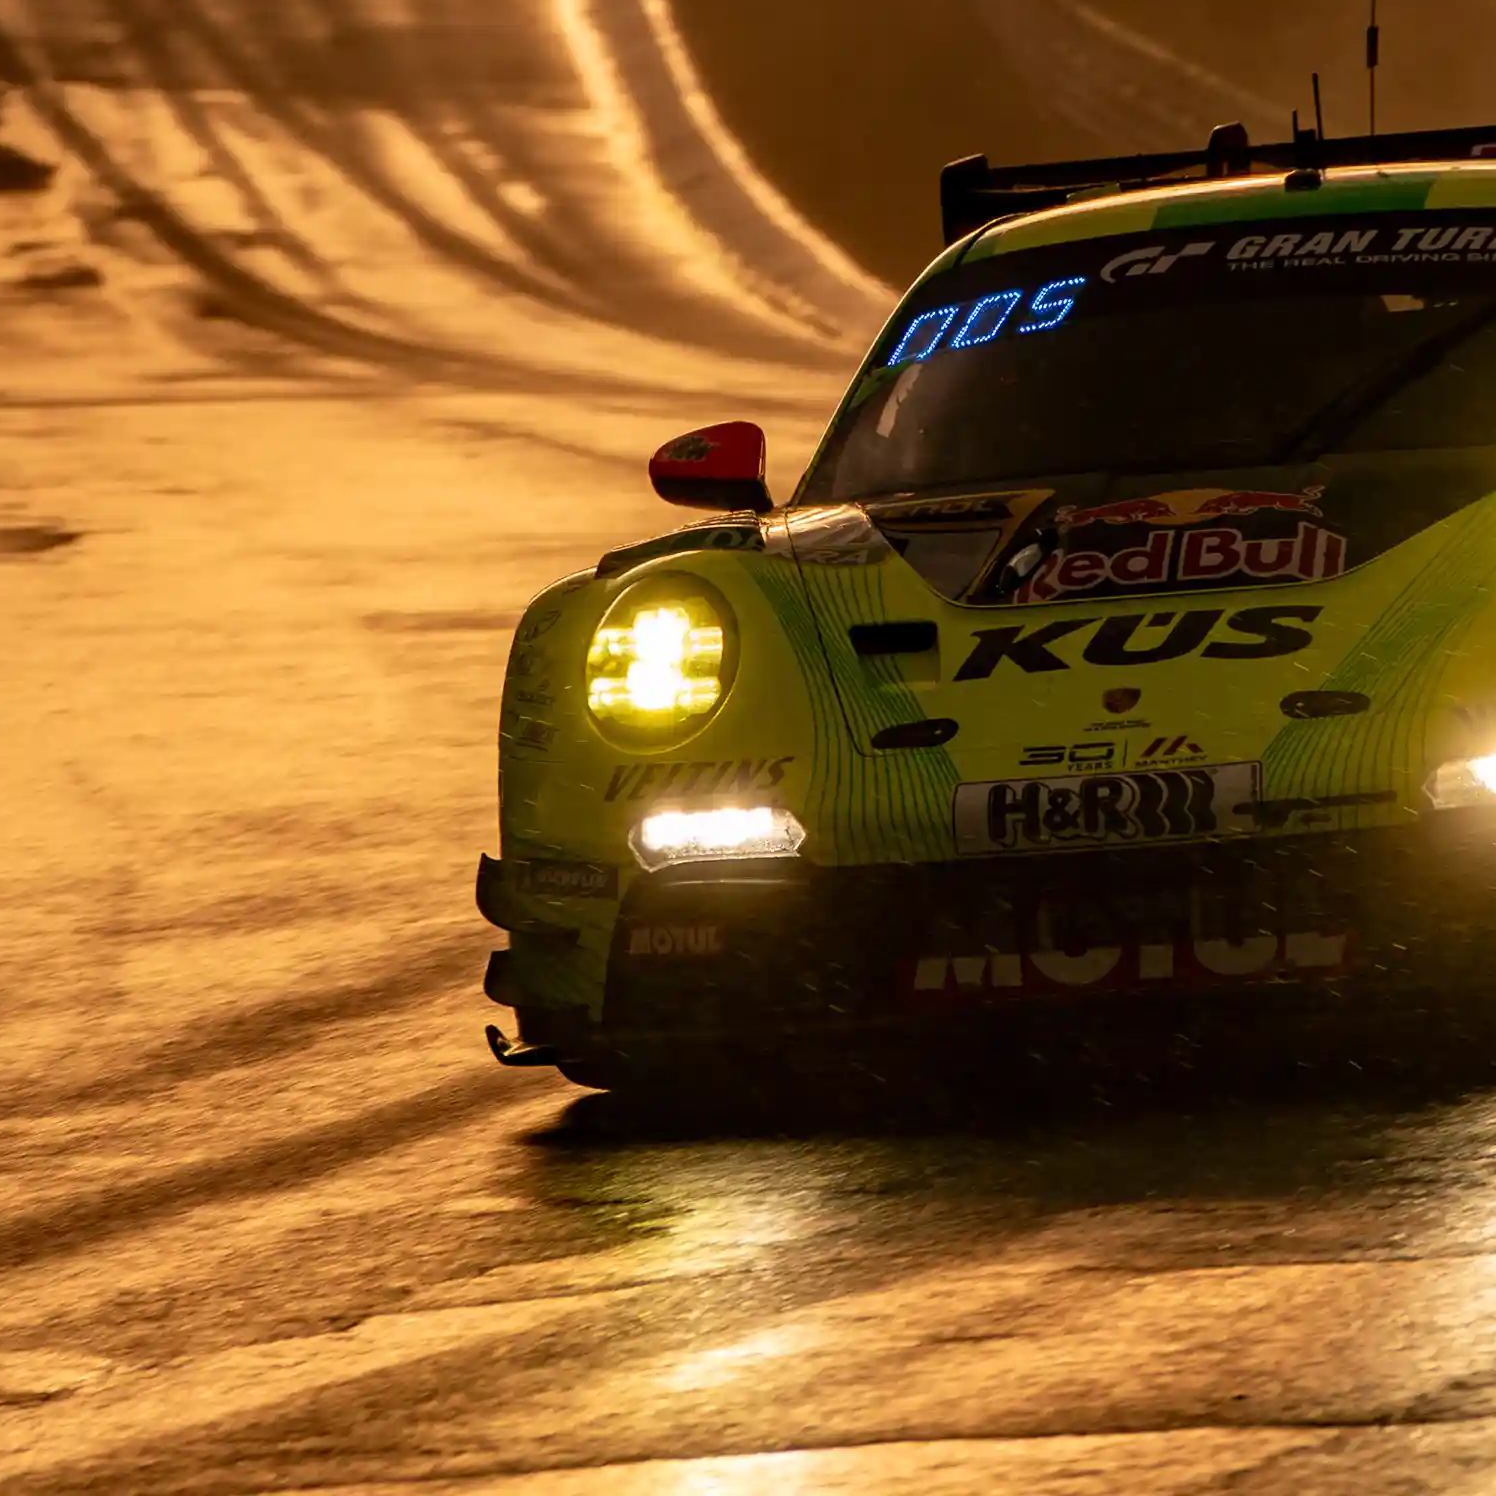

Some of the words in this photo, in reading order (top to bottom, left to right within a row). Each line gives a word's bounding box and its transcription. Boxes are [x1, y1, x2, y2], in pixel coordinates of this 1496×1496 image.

[1226, 227, 1378, 261] GRAN
[1227, 258, 1275, 273] THE
[1283, 255, 1347, 269] REAL
[1355, 252, 1463, 265] DRIVING
[1176, 520, 1349, 582] Bull
[953, 605, 1326, 682] KÜS
[1018, 741, 1116, 767] 30
[1068, 761, 1113, 773] YEARS
[1134, 754, 1209, 768] MANTHEY
[987, 775, 1138, 848] H&R
[628, 923, 726, 955] MOTUL
